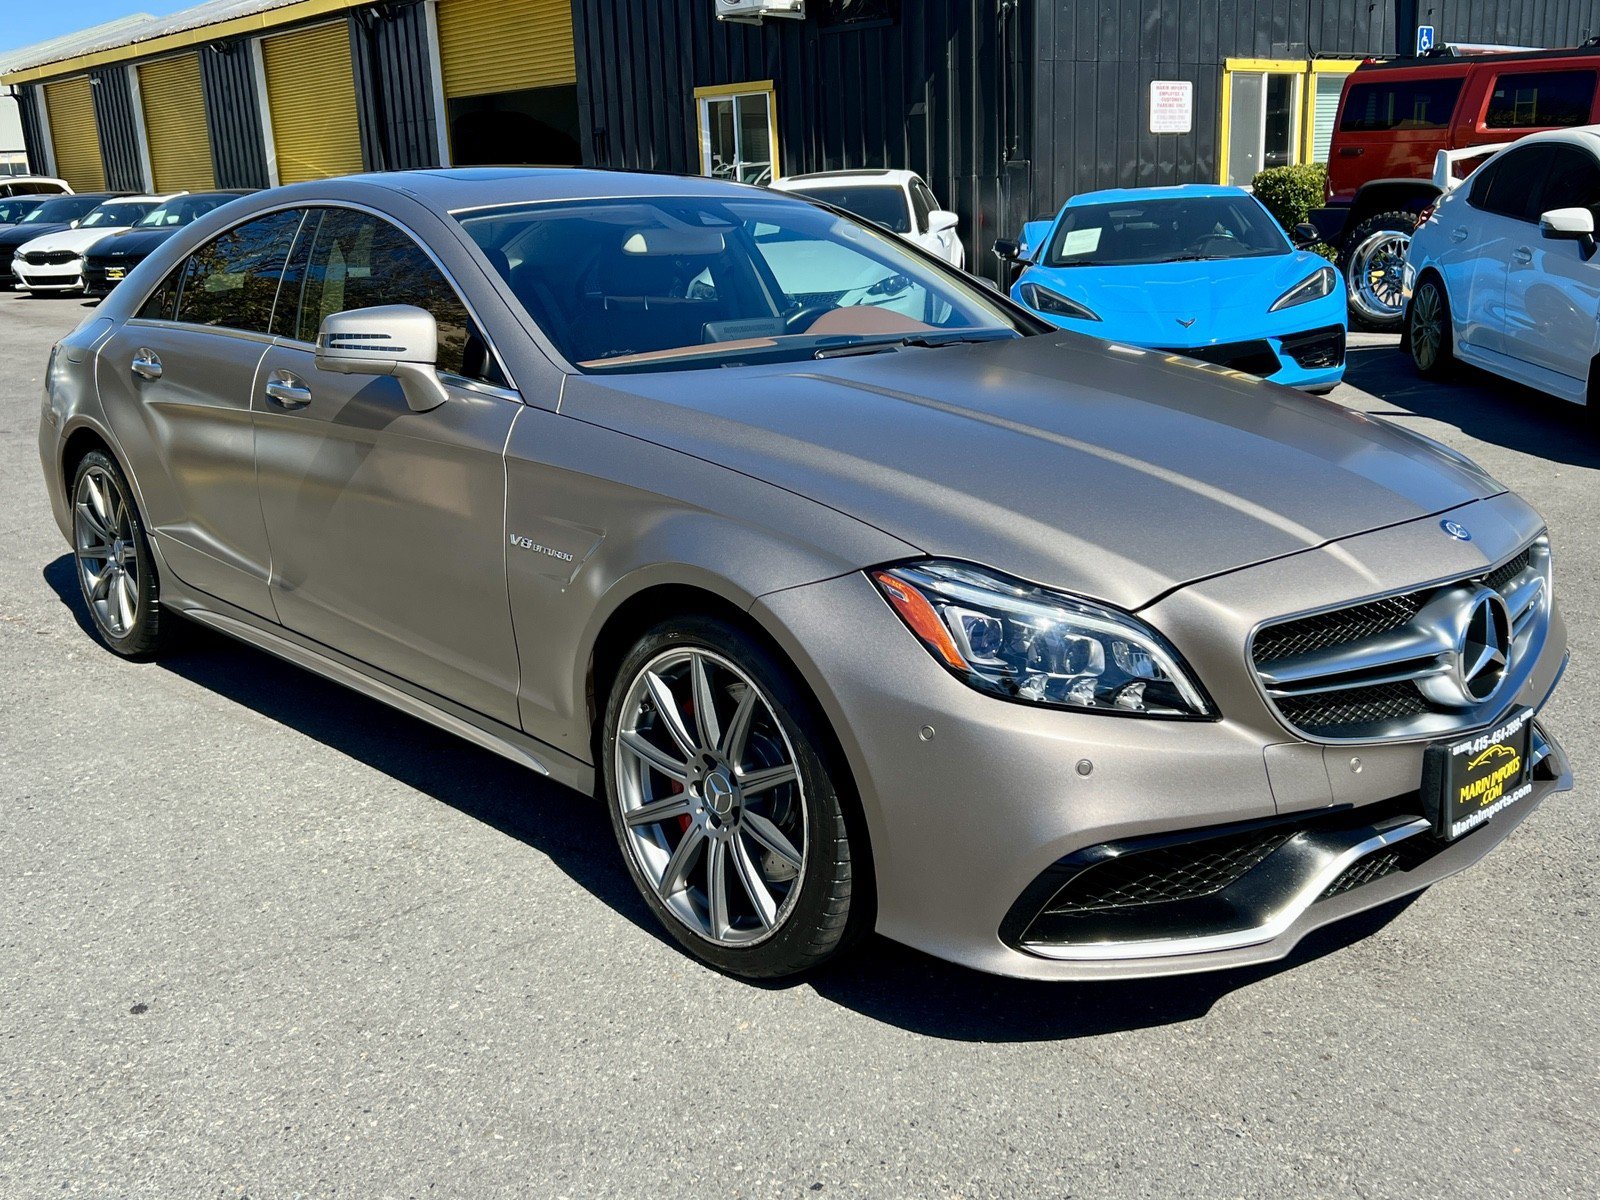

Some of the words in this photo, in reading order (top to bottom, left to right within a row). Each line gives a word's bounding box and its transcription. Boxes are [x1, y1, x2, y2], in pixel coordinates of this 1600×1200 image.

[509, 533, 533, 549] V8
[532, 543, 574, 562] BITURBO
[1459, 774, 1491, 804] MARIN
[1490, 756, 1521, 787] IMPORTS
[1480, 784, 1503, 807] .COM
[1452, 783, 1532, 838] MarinImports.com
